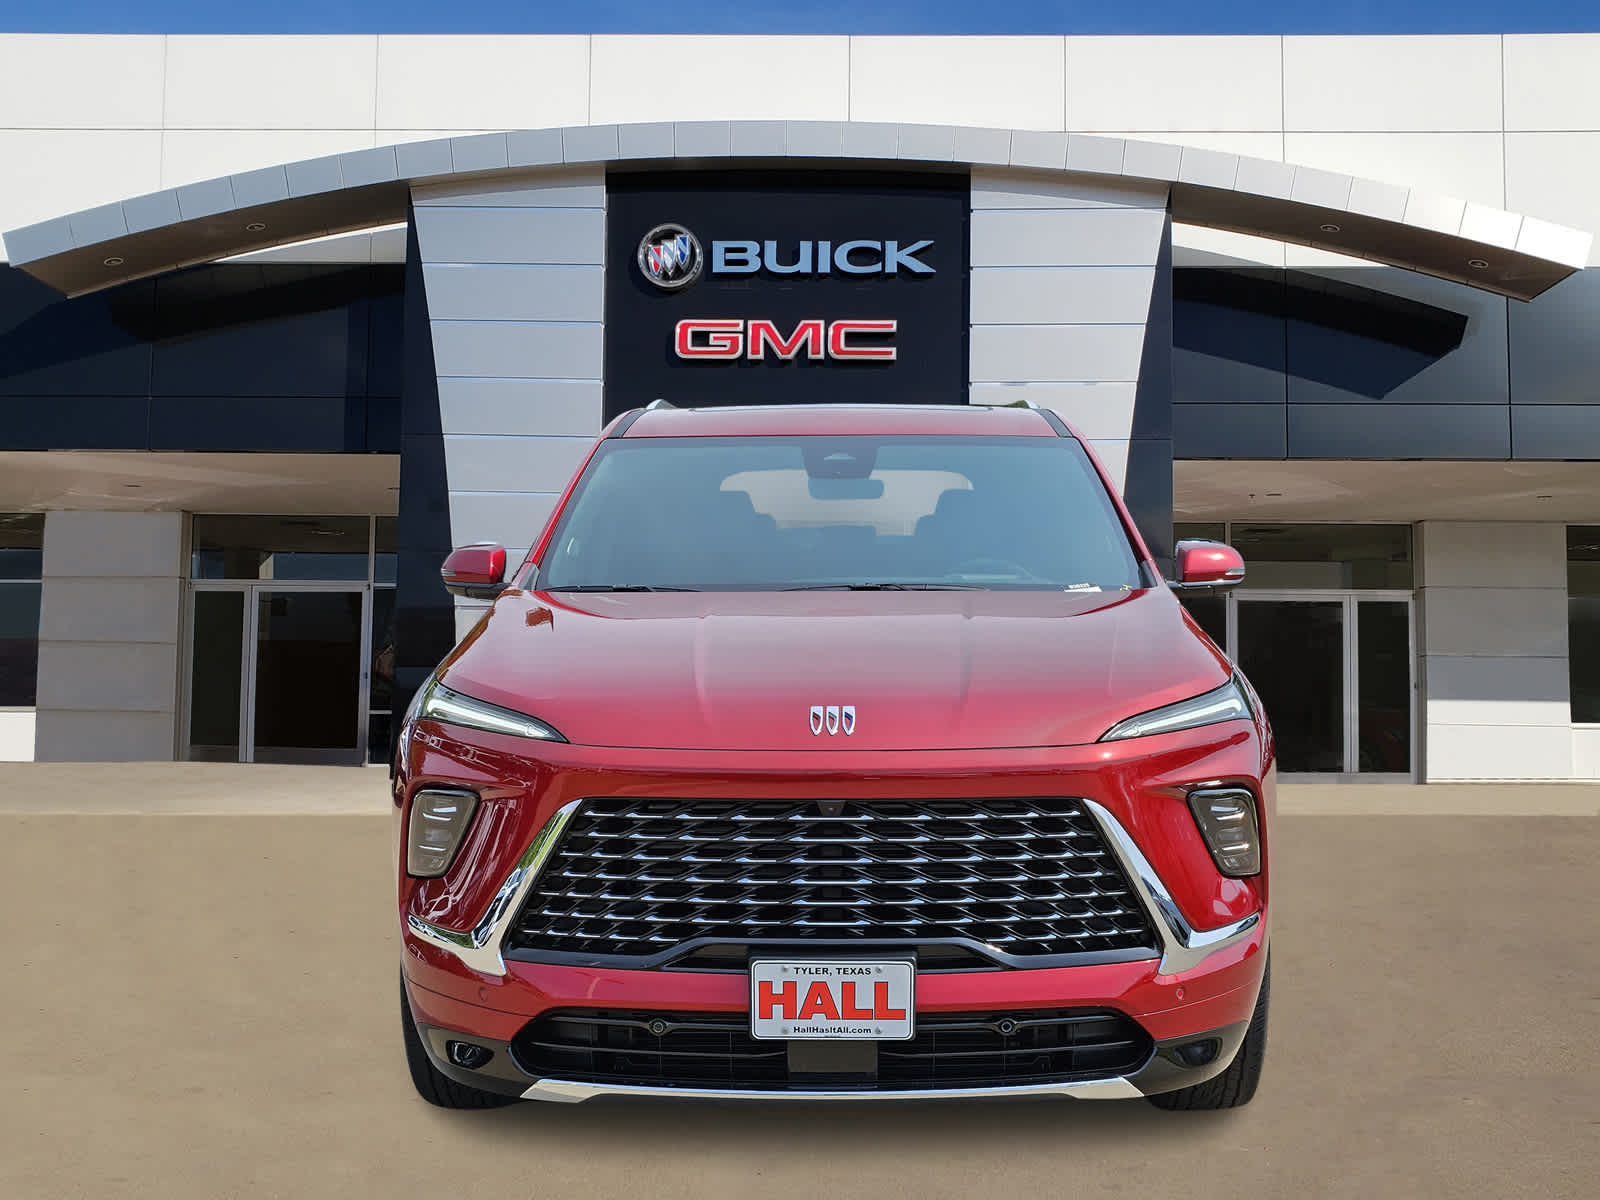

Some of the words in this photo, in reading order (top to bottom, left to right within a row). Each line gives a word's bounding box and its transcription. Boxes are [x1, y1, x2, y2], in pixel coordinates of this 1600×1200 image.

[712, 240, 937, 274] BUICK
[675, 319, 898, 360] GMC
[794, 967, 832, 977] TYLER,
[836, 967, 872, 976] TEXAS
[758, 980, 907, 1021] HALL
[793, 1025, 872, 1035] HallHasItAll.com
